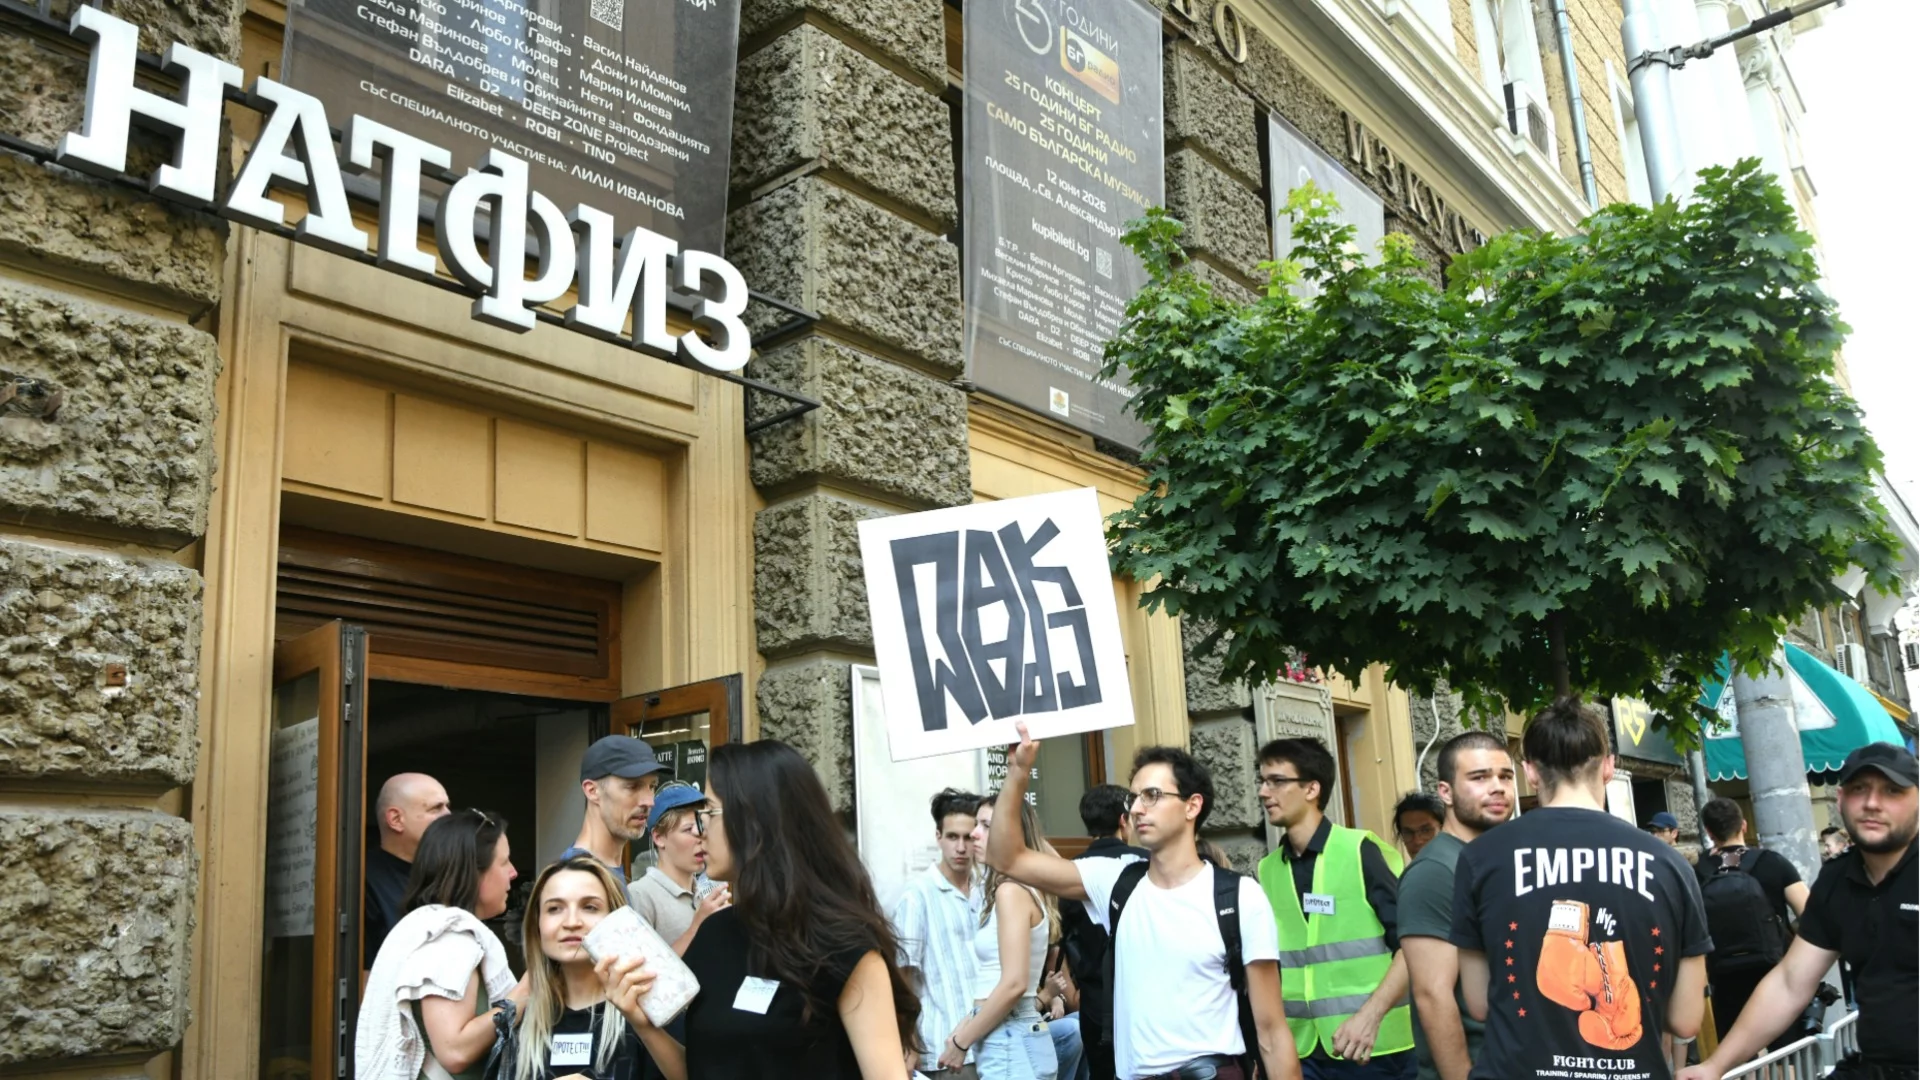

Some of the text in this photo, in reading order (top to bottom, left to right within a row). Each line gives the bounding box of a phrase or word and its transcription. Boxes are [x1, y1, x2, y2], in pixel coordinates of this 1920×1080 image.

[1060, 0, 1118, 56] ГОДИНИ
[1067, 45, 1084, 63] БГ
[357, 5, 690, 162] Стефан Вълдобрев и Обичайните заподозрени
[410, 8, 489, 54] Маринова
[512, 56, 560, 89] Молец
[581, 87, 613, 110] Нети
[633, 111, 710, 155] Фондацията
[470, 19, 511, 46] Любо
[514, 38, 558, 67] Киров
[580, 69, 623, 98] Мария
[626, 90, 672, 120] Илиева
[528, 27, 572, 57] Графа
[591, 58, 628, 83] Дони
[630, 77, 638, 88] и
[641, 81, 692, 113] Момчил
[583, 35, 622, 63] Васил
[625, 56, 687, 94] Найденов
[410, 48, 649, 161] DARA D2 DEEP ZONE Project
[447, 83, 616, 164] Elizabet ROBI TINO
[1004, 70, 1136, 164] 25 ГОДИНИ БГ РАДИО
[1045, 75, 1102, 121] КОНЦЕРТ
[390, 92, 489, 140] СПЕЦИАЛНОТО
[491, 132, 546, 164] УЧАСТИЕ
[548, 157, 567, 173] НА:
[571, 165, 614, 191] ЛИЛИ
[617, 182, 685, 220] ИВАНОВА
[986, 102, 1151, 209] САМО БЪЛГАРСКА МУЗИКА
[1040, 113, 1108, 165] 25 ГОДИНИ
[56, 4, 752, 373] НАТФИЗ
[985, 155, 1031, 190] площад
[1056, 193, 1116, 236] Александър
[1046, 168, 1107, 213] 12 юни 2026
[1341, 111, 1488, 253] ИЗКУС
[1032, 216, 1090, 262] kupibileti.bg
[1006, 265, 1033, 286] Криско
[1043, 284, 1063, 301] Любо
[1063, 294, 1086, 311] Киров
[1016, 283, 1054, 308] Маринова
[1069, 284, 1091, 301] Графа
[1018, 310, 1041, 328] DARA
[1050, 324, 1061, 337] D2
[1070, 333, 1090, 348] DEEP
[1036, 331, 1090, 362] Elizabet ROBI
[1514, 847, 1655, 902] EMPIRE
[1596, 907, 1617, 936] NYC
[1536, 1070, 1569, 1078] TRAINING
[1574, 1072, 1607, 1080] SPARRING
[1552, 1055, 1635, 1070] FIGHT CLUB
